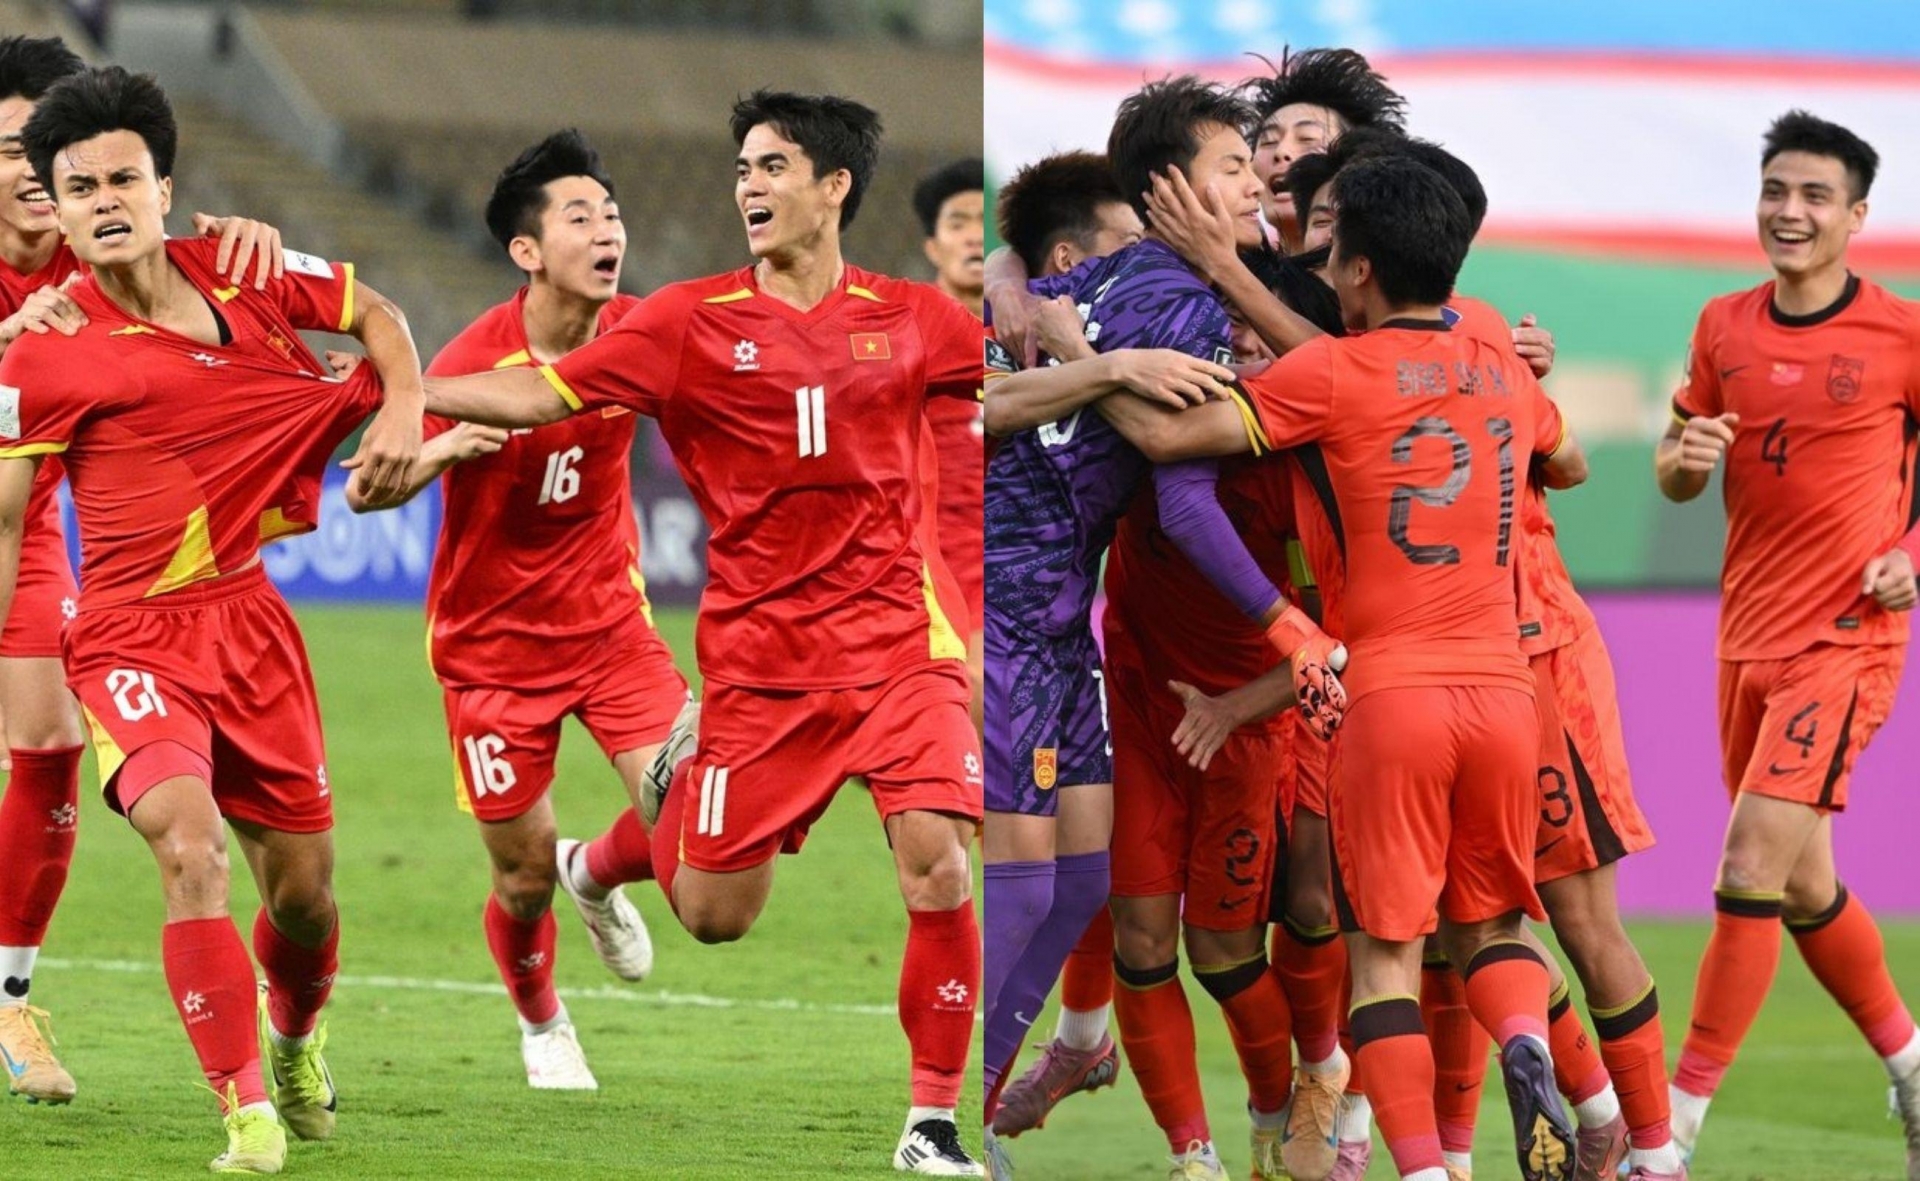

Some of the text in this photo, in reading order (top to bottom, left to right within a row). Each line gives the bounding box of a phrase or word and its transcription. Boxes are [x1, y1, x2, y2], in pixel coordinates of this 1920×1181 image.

[795, 385, 828, 459] 11
[1761, 418, 1788, 477] 4
[537, 445, 584, 505] 16
[1387, 416, 1513, 566] 21
[105, 669, 168, 722] 21
[1786, 701, 1820, 758] 4
[462, 733, 517, 799] 16
[697, 765, 729, 837] 11
[1226, 828, 1259, 886] 2
